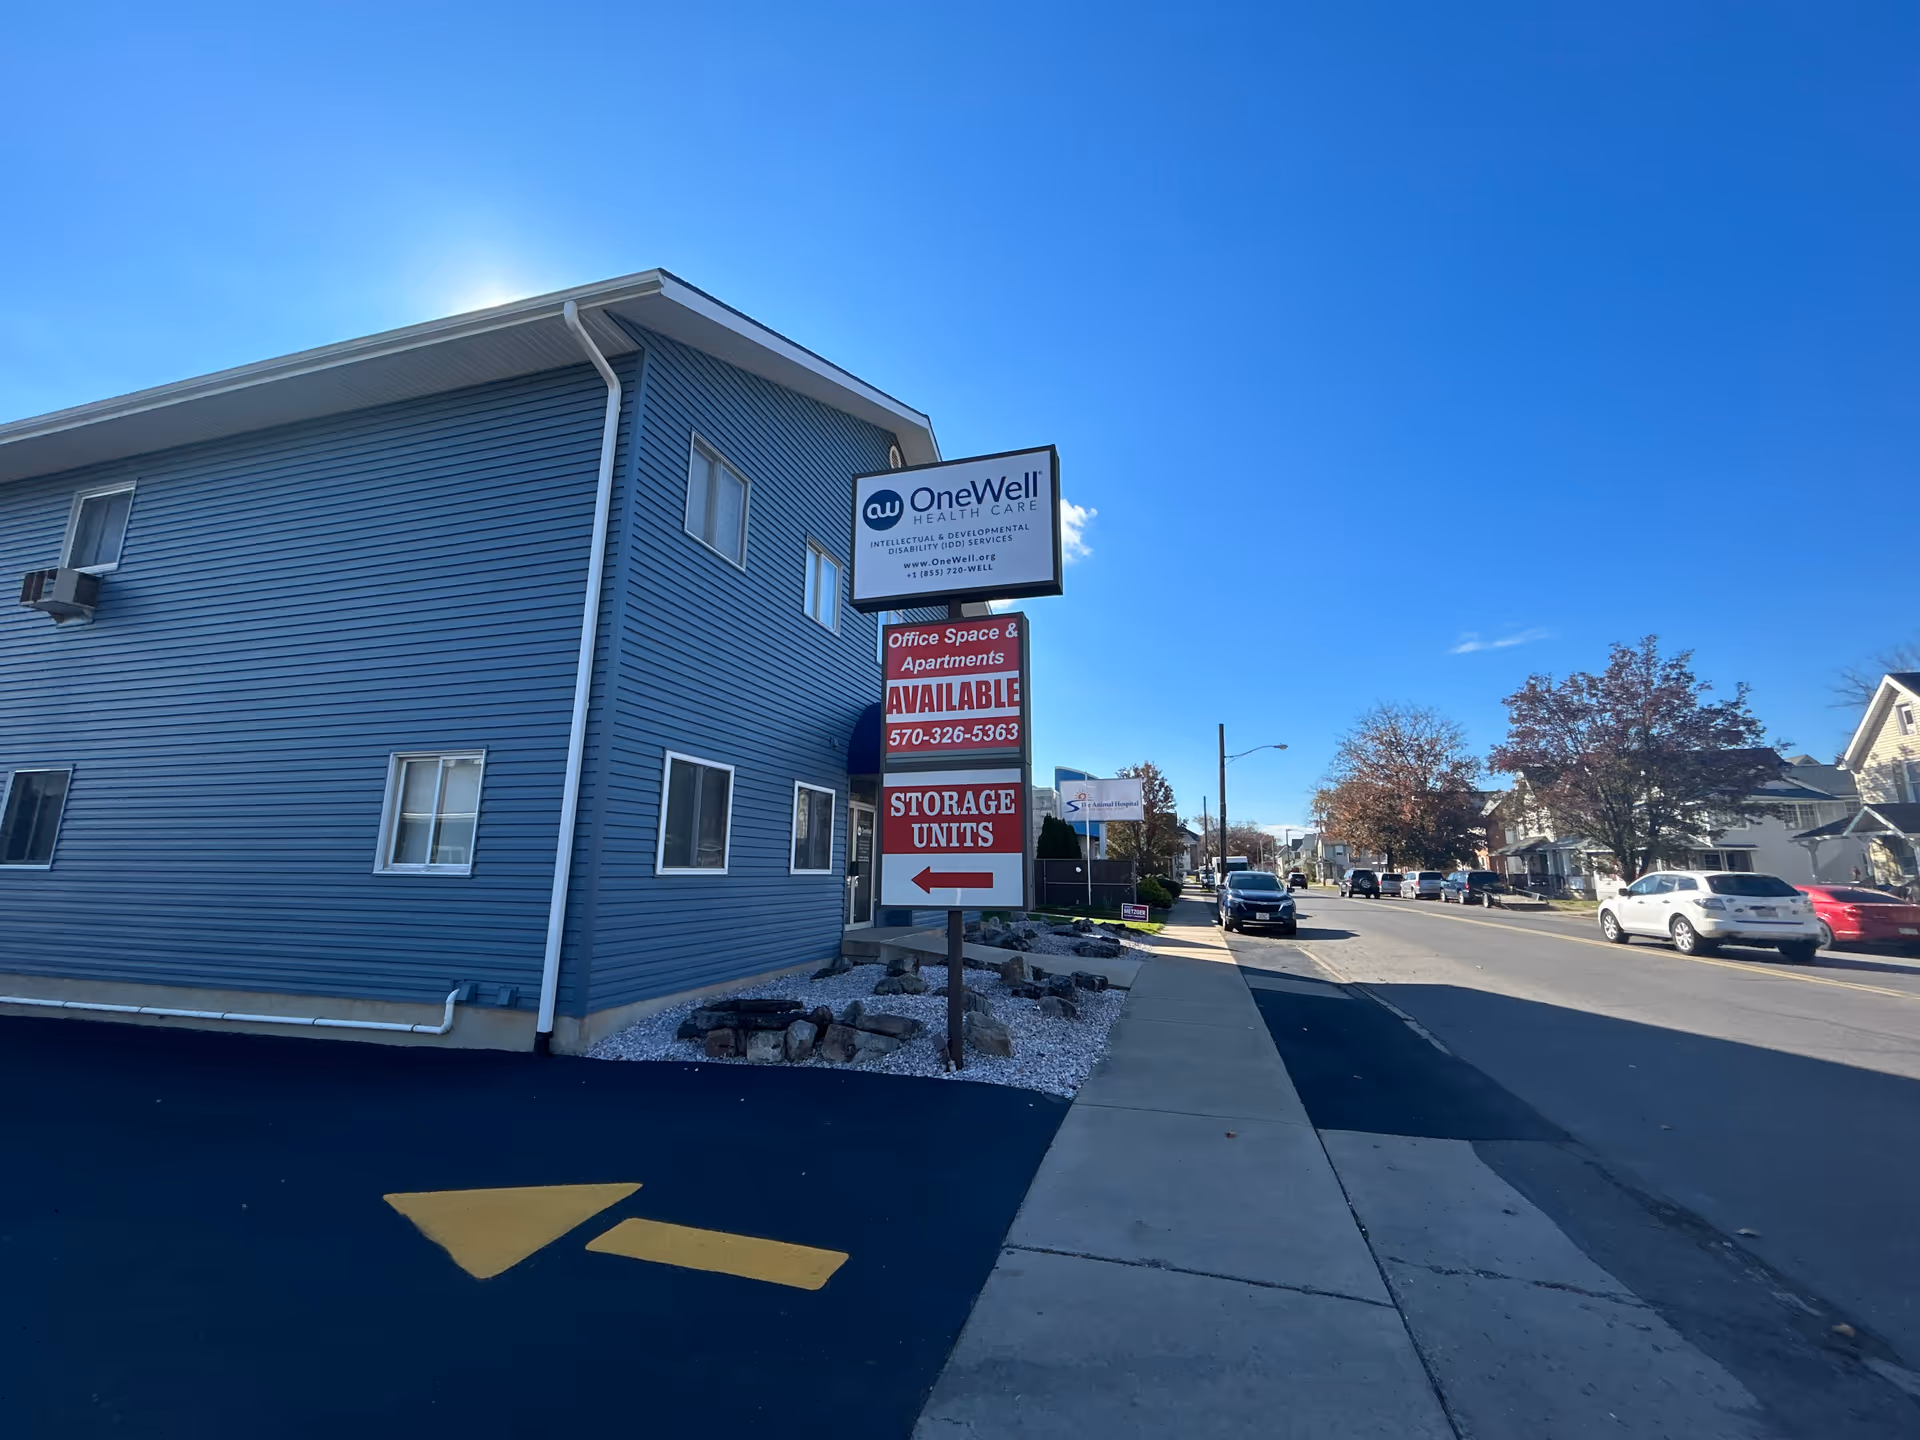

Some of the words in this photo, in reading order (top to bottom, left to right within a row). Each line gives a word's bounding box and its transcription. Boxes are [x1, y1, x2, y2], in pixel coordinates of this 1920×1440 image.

[913, 508, 979, 525] HEALTH
[991, 500, 1038, 516] CARE
[870, 535, 935, 549] INTELLECTUAL
[938, 533, 944, 541] &
[948, 524, 1029, 540] DEVELOPMENTAL
[888, 543, 938, 555] DISABILITY
[941, 540, 965, 550] (IDD)
[968, 535, 1013, 546] SERVICES
[903, 553, 996, 569] www.OneWell.org
[907, 571, 917, 579] +1
[920, 568, 944, 579] (855)
[946, 563, 993, 575] 720-WELL
[888, 630, 939, 648] Office
[944, 626, 999, 646] Space
[1005, 622, 1018, 638] &
[900, 650, 1005, 674] Apartments
[886, 677, 1020, 715] AVAILABLE
[889, 723, 1019, 746] 570-326-5363
[890, 789, 1015, 817] STORAGE
[1114, 801, 1139, 809] Hospital
[911, 822, 994, 848] UNITS
